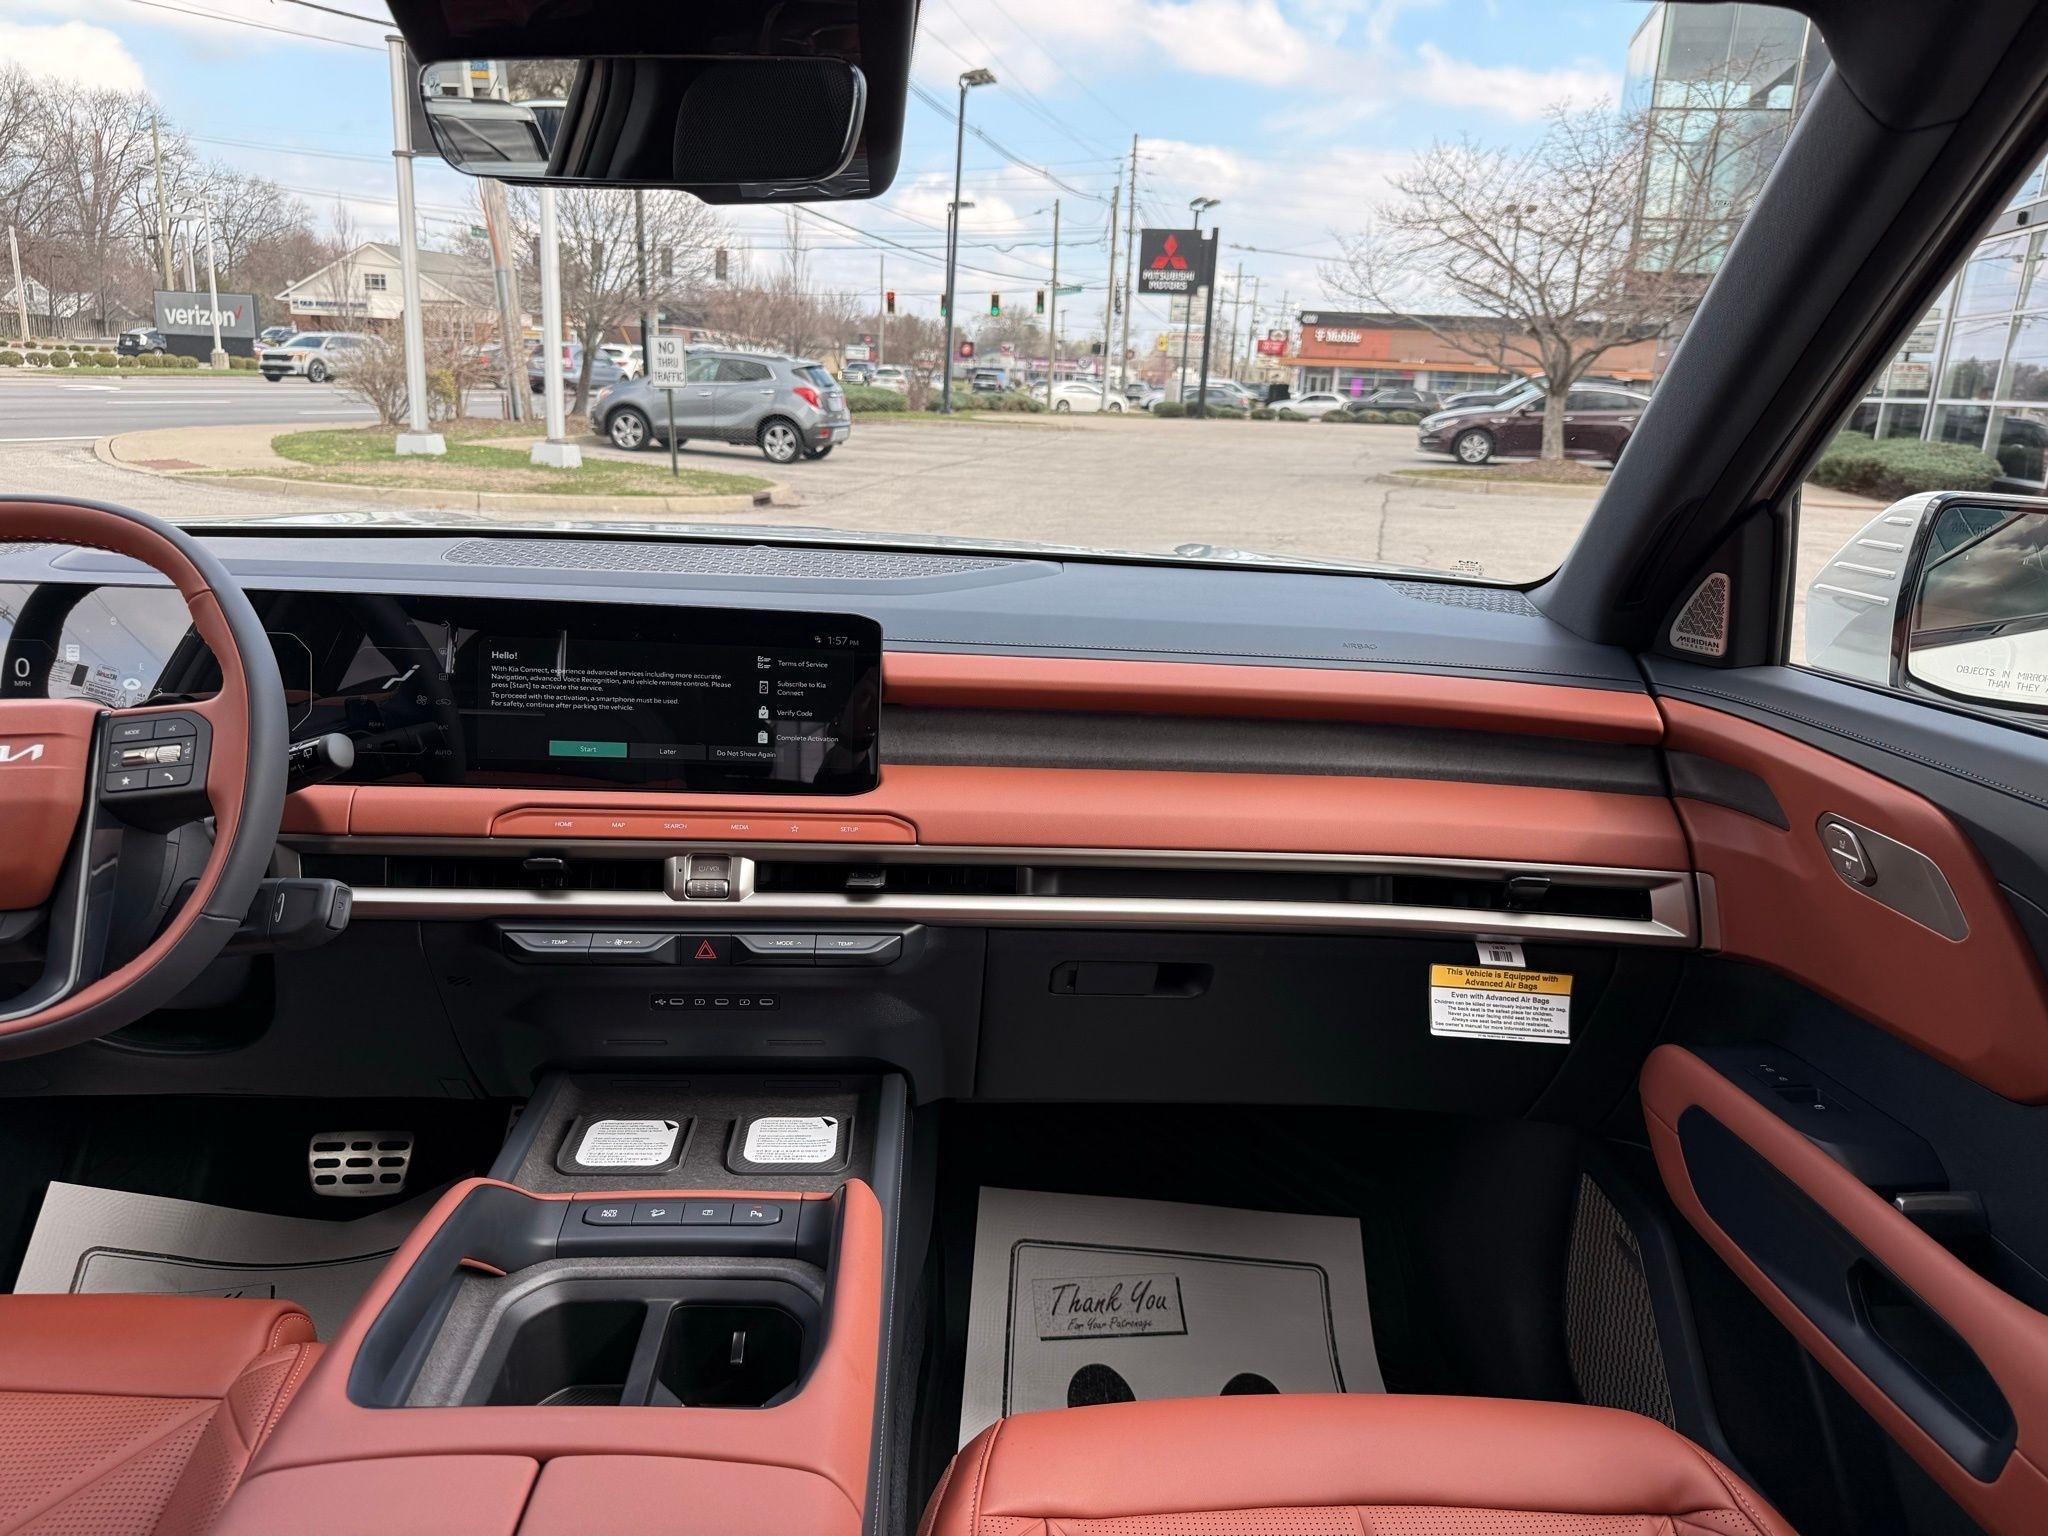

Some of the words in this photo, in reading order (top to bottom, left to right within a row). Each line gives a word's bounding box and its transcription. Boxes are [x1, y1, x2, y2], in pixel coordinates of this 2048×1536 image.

[1142, 269, 1195, 281] MITSUBISHI
[1148, 281, 1188, 290] MOTORS
[164, 304, 235, 327] verizon
[658, 341, 675, 354] NO
[657, 357, 679, 368] THRU
[654, 371, 685, 382] TRAFFIC
[828, 636, 848, 646] 1:57
[1342, 642, 1378, 650] AIRBAG
[1677, 635, 1719, 648] MERIDIAN
[491, 651, 518, 660] Hello!
[15, 657, 30, 678] 0
[777, 660, 798, 668] Terms
[805, 661, 829, 669] Service
[550, 668, 586, 677] experience
[645, 671, 674, 679] including
[1956, 664, 1996, 677] OBJECTS
[2002, 670, 2011, 679] IN
[491, 673, 529, 682] Navigation,
[581, 676, 622, 685] Recognition,
[683, 680, 711, 688] controls.
[711, 681, 732, 689] Please
[777, 680, 808, 688] Subscribe
[1987, 678, 2011, 689] THAN
[2016, 682, 2041, 693] THEY
[540, 683, 567, 691] activate
[500, 692, 527, 700] proceed
[555, 694, 590, 702] activation,
[595, 696, 635, 704] smartphone
[777, 689, 804, 697] Connect
[503, 701, 525, 709] safety,
[572, 703, 598, 711] parking
[776, 709, 796, 718] Verify
[776, 734, 807, 743] Complete
[807, 735, 839, 743] Activation
[580, 745, 597, 753] Start
[758, 751, 777, 759] Again
[1465, 969, 1493, 977] Vehicle
[1503, 971, 1541, 981] Equipped
[1542, 975, 1559, 983] with
[1464, 978, 1503, 988] Advanced
[1504, 981, 1517, 989] Air
[1518, 982, 1538, 991] Bags
[1451, 991, 1468, 999] Even
[1485, 994, 1519, 1003] Advanced
[1532, 997, 1550, 1005] Bags
[1051, 1281, 1123, 1316] Thank
[1130, 1279, 1168, 1313] You
[1067, 1317, 1084, 1330] For
[1087, 1316, 1107, 1331] Your
[1108, 1316, 1153, 1331] Patronage
